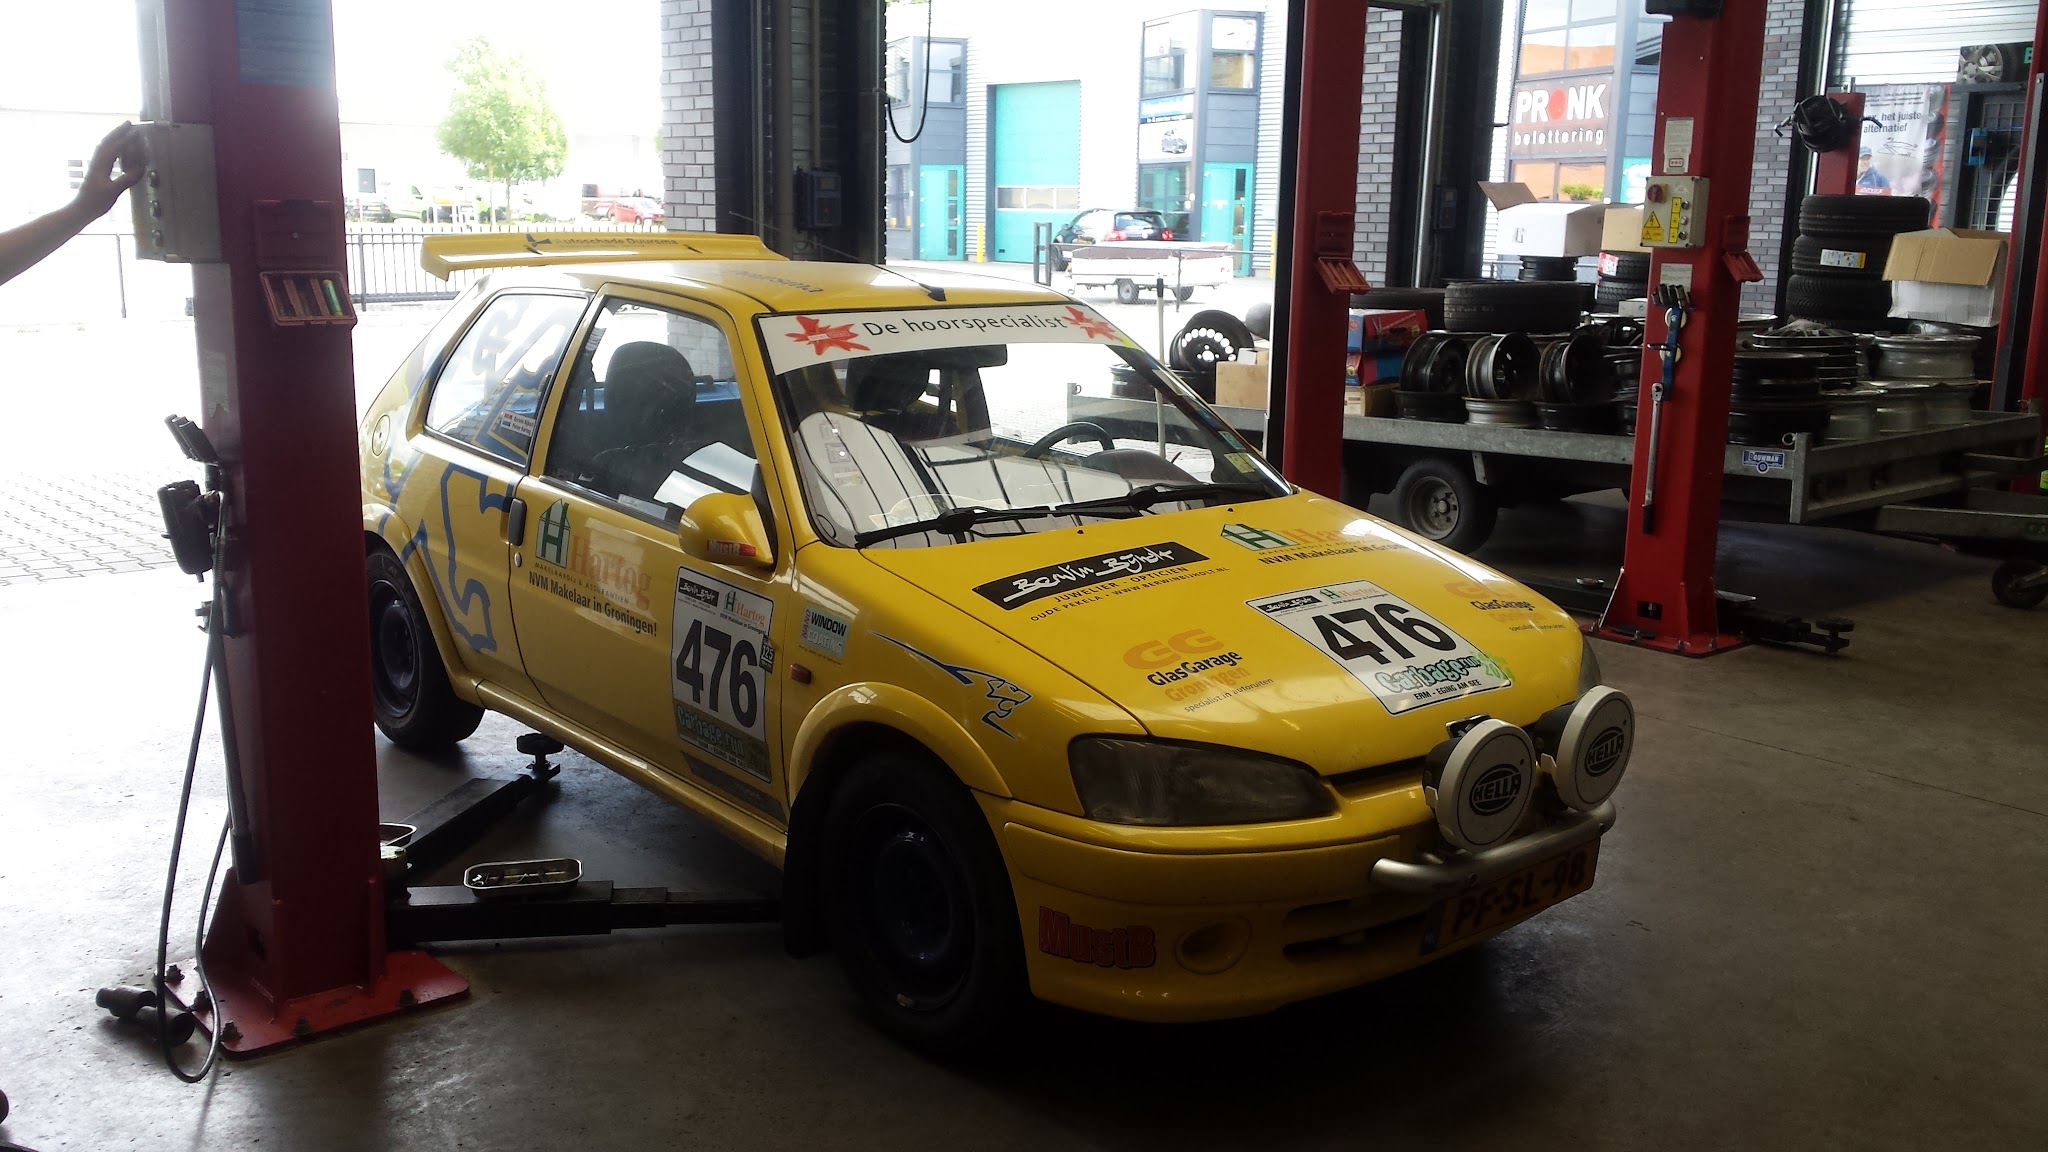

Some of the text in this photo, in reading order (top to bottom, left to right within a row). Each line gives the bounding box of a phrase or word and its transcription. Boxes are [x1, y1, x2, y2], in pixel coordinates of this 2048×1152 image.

[1863, 122, 1908, 134] alternatief
[1882, 112, 1895, 121] het
[1898, 110, 1922, 122] juiste
[1514, 128, 1604, 145] belettering
[862, 314, 1068, 337] De hoorspecialist
[1258, 553, 1297, 565] NVM
[1294, 546, 1358, 560] Makelaar
[569, 535, 652, 611] Hartog
[1053, 581, 1120, 603] JUWELIER
[1131, 567, 1189, 584] OPTICIEN
[529, 570, 549, 592] NVM
[550, 579, 591, 609] Makelaar
[593, 596, 602, 614] in
[604, 602, 658, 637] Groningen!
[736, 602, 767, 628] Hartog
[1030, 605, 1062, 622] OUDE
[1062, 594, 1103, 609] PEKELA
[802, 609, 811, 639] NANO
[811, 611, 847, 637] WINDOW
[1311, 603, 1457, 665] 476
[762, 645, 774, 661] 125
[1123, 628, 1225, 670] GG
[676, 618, 758, 728] 476
[1146, 651, 1243, 686] GlasGarage
[1164, 666, 1251, 702] Groningen
[1184, 678, 1274, 713] specialist in autoruiten
[1413, 691, 1432, 701] ERM
[1437, 685, 1458, 695] EGING
[1457, 682, 1468, 692] AM
[1468, 679, 1482, 688] SEE
[1588, 736, 1625, 763] HELLA
[1472, 772, 1522, 800] HELLA
[1039, 905, 1157, 969] MustB
